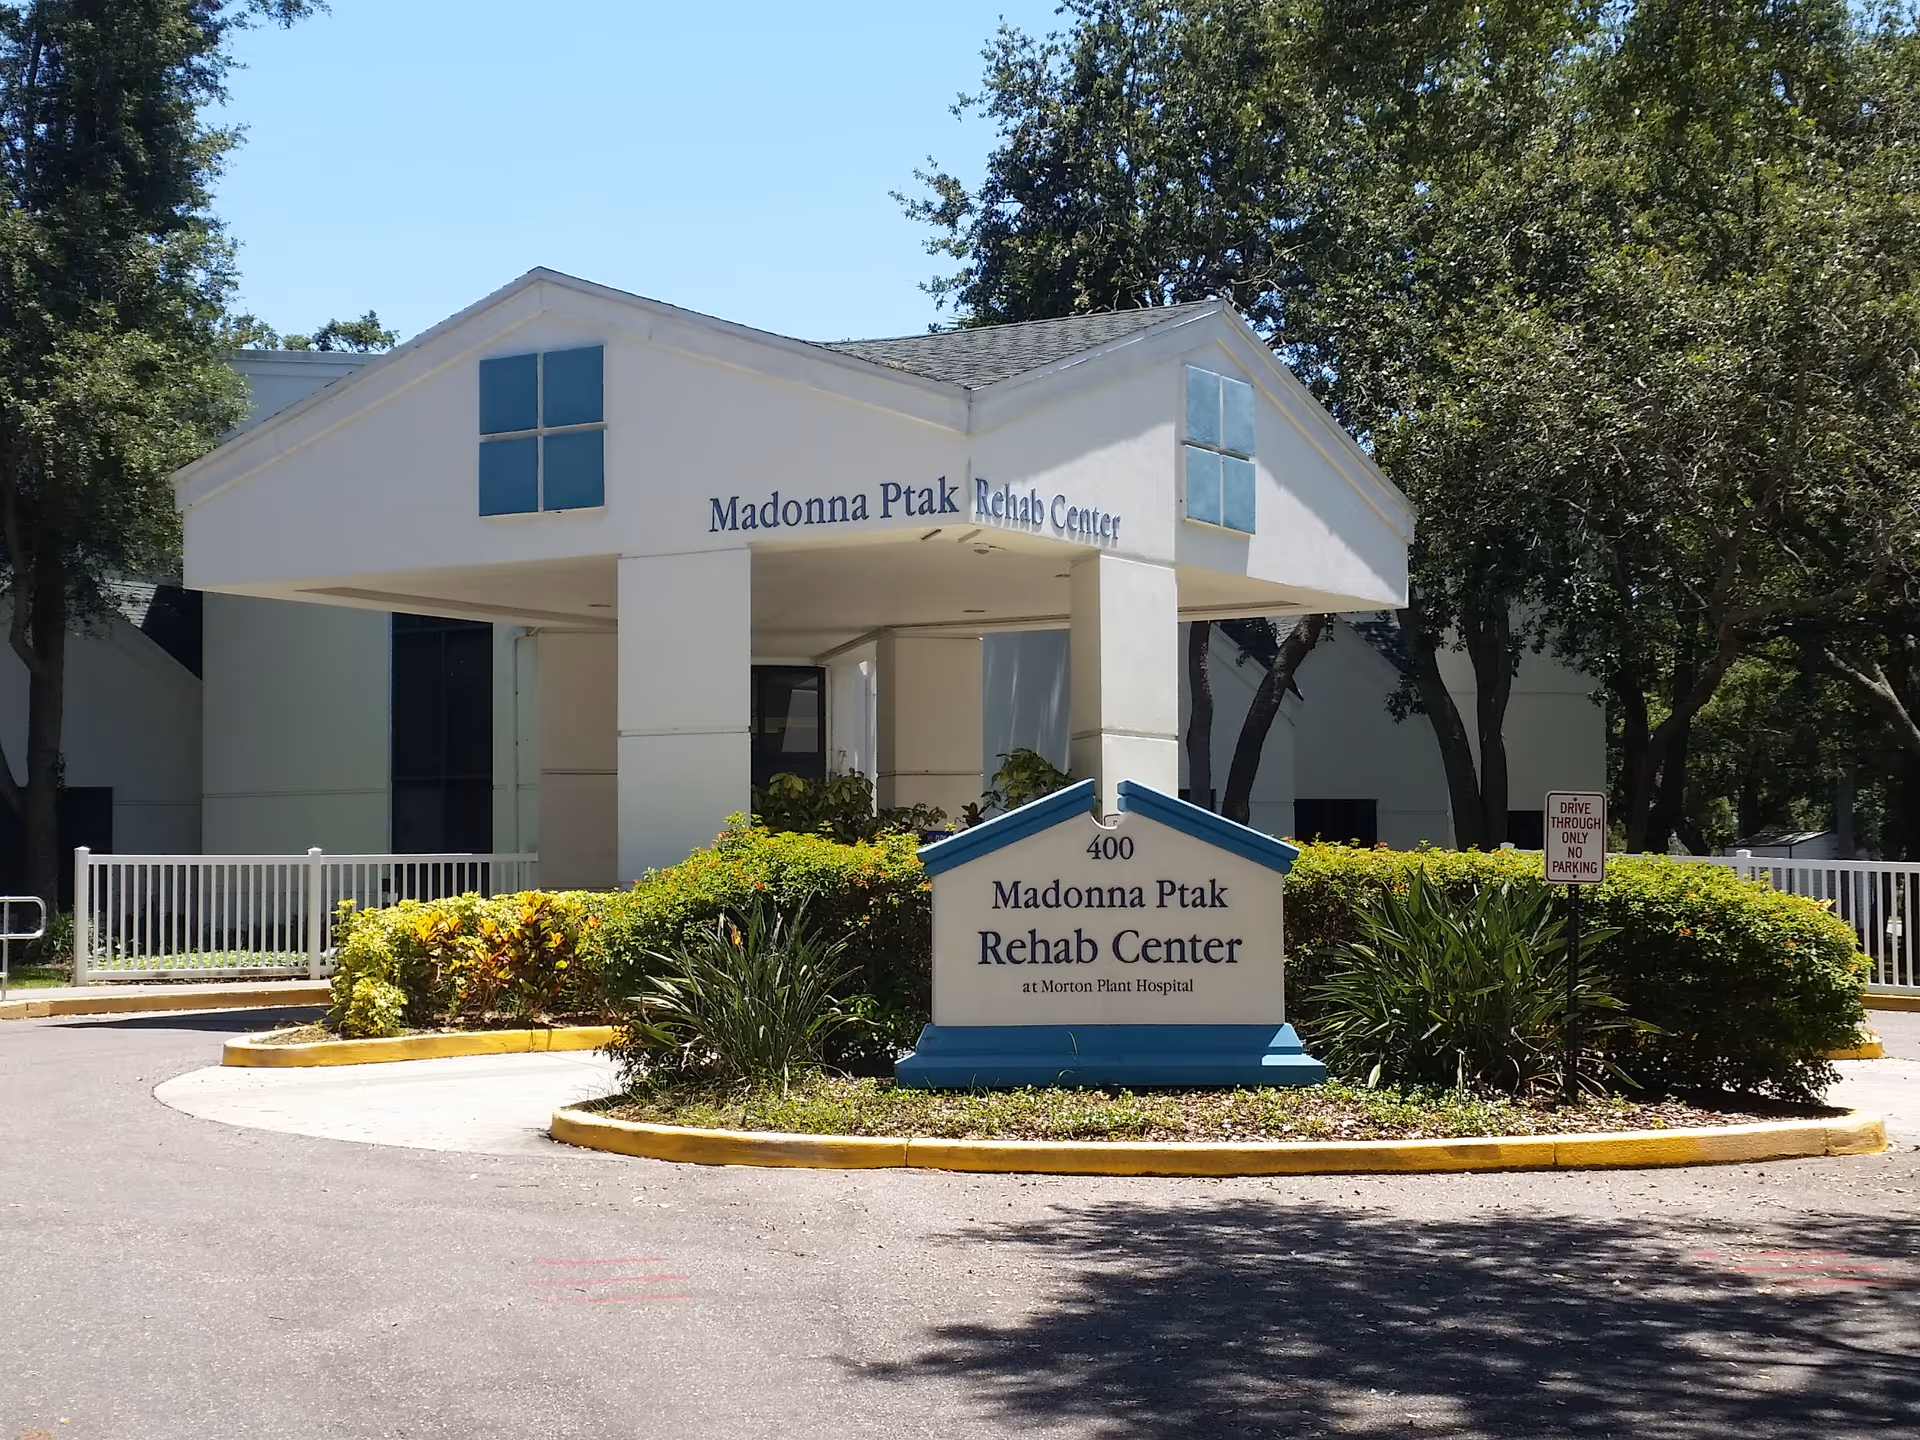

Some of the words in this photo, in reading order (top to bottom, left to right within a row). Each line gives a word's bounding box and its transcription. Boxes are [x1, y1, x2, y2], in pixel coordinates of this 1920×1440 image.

[708, 490, 870, 533] Madonna
[879, 475, 960, 519] Ptak
[974, 477, 1045, 526] Rehab
[1050, 493, 1122, 540] Center
[1560, 802, 1591, 815] DRIVE
[1551, 816, 1601, 830] THROUGH
[1561, 831, 1589, 844] ONLY
[1086, 834, 1135, 861] 400
[1567, 846, 1583, 859] NO
[1552, 860, 1598, 874] PARKING
[991, 879, 1146, 910] Madonna
[1155, 878, 1229, 909] Ptak
[977, 928, 1099, 965] Rehab
[1112, 929, 1244, 964] Center
[1022, 980, 1038, 993] at
[1041, 979, 1093, 993] Morton
[1096, 979, 1132, 993] Plant
[1136, 978, 1194, 996] Hospital
